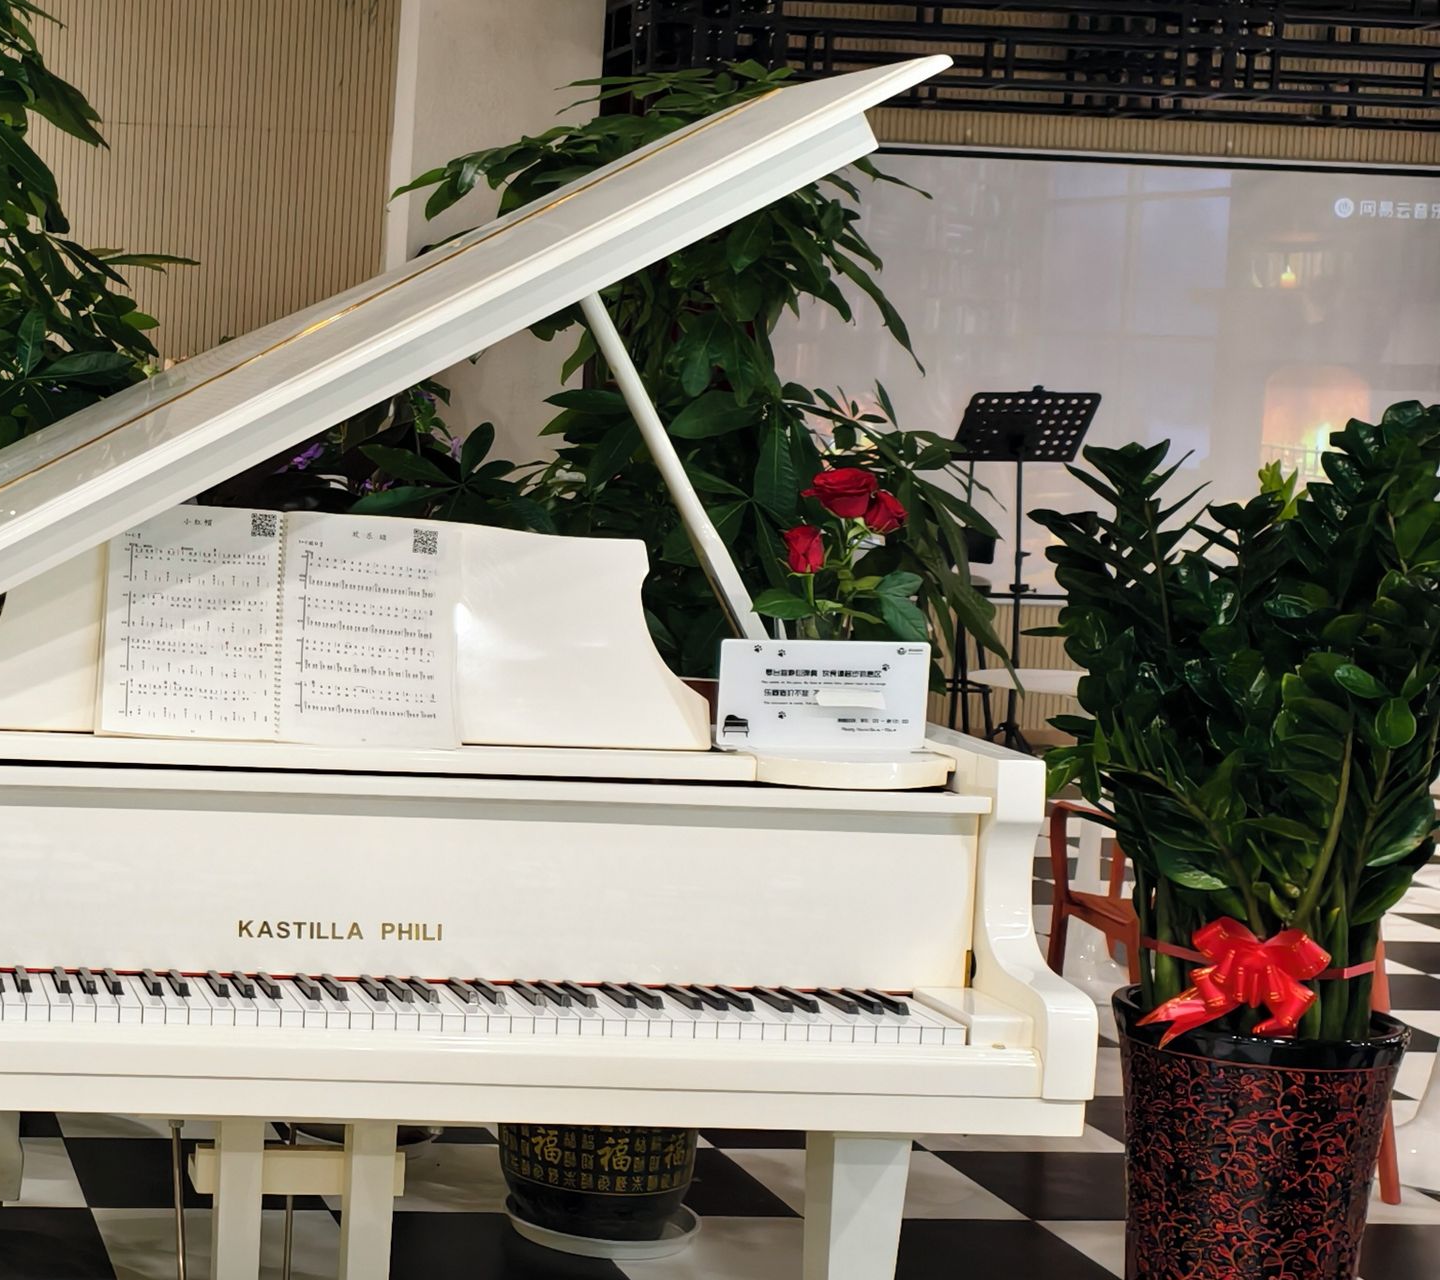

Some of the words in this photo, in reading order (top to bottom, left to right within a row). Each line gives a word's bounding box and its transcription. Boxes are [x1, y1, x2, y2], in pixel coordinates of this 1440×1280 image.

[238, 919, 364, 940] KASTILLA
[381, 922, 443, 941] PHILI
[531, 1126, 563, 1165] 福
[596, 1136, 632, 1172] 福
